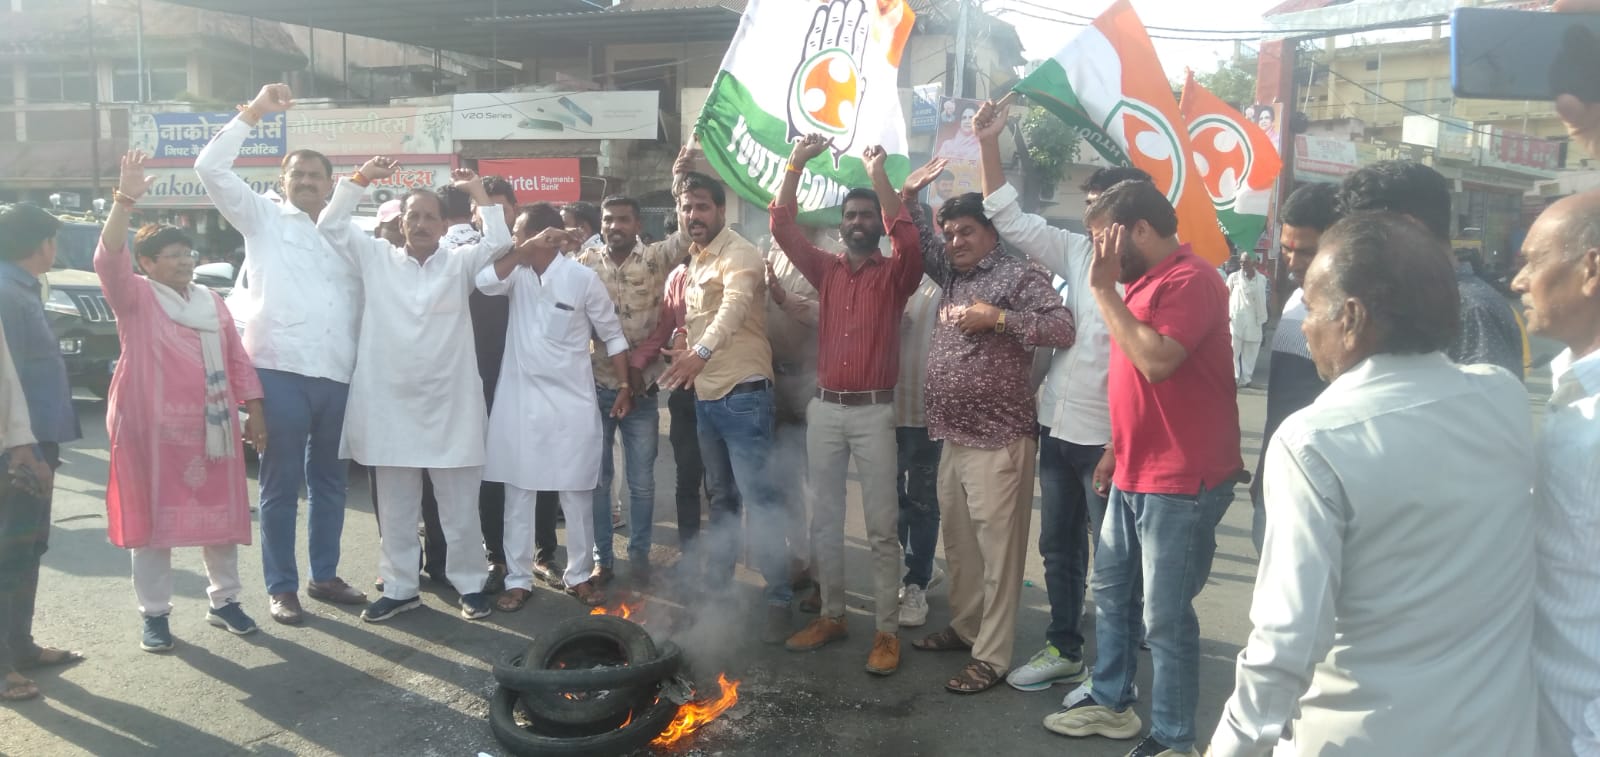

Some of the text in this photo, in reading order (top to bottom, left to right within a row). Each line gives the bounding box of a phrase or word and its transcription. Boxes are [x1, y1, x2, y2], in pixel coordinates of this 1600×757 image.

[461, 112, 512, 120] V20 Series
[508, 176, 540, 191] irtel
[541, 176, 574, 184] Payments
[541, 183, 560, 191] Bank
